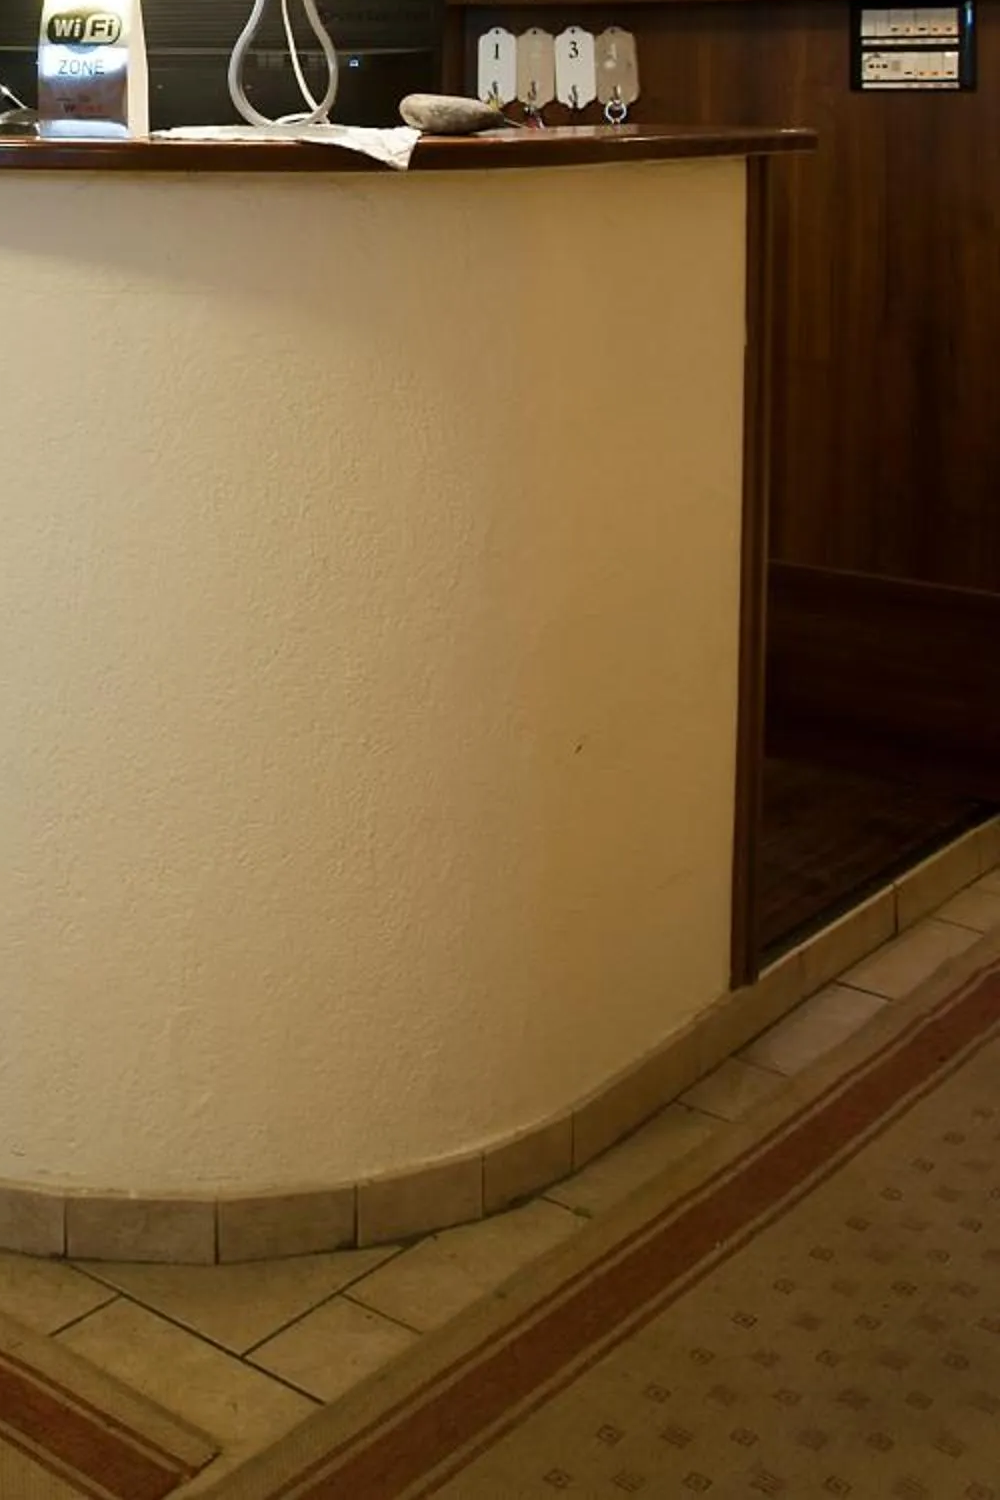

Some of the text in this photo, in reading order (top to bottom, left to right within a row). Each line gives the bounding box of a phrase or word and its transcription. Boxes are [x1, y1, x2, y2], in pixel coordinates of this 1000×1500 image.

[493, 43, 500, 60] 1
[568, 41, 579, 59] 3
[57, 59, 105, 75] ZONE
